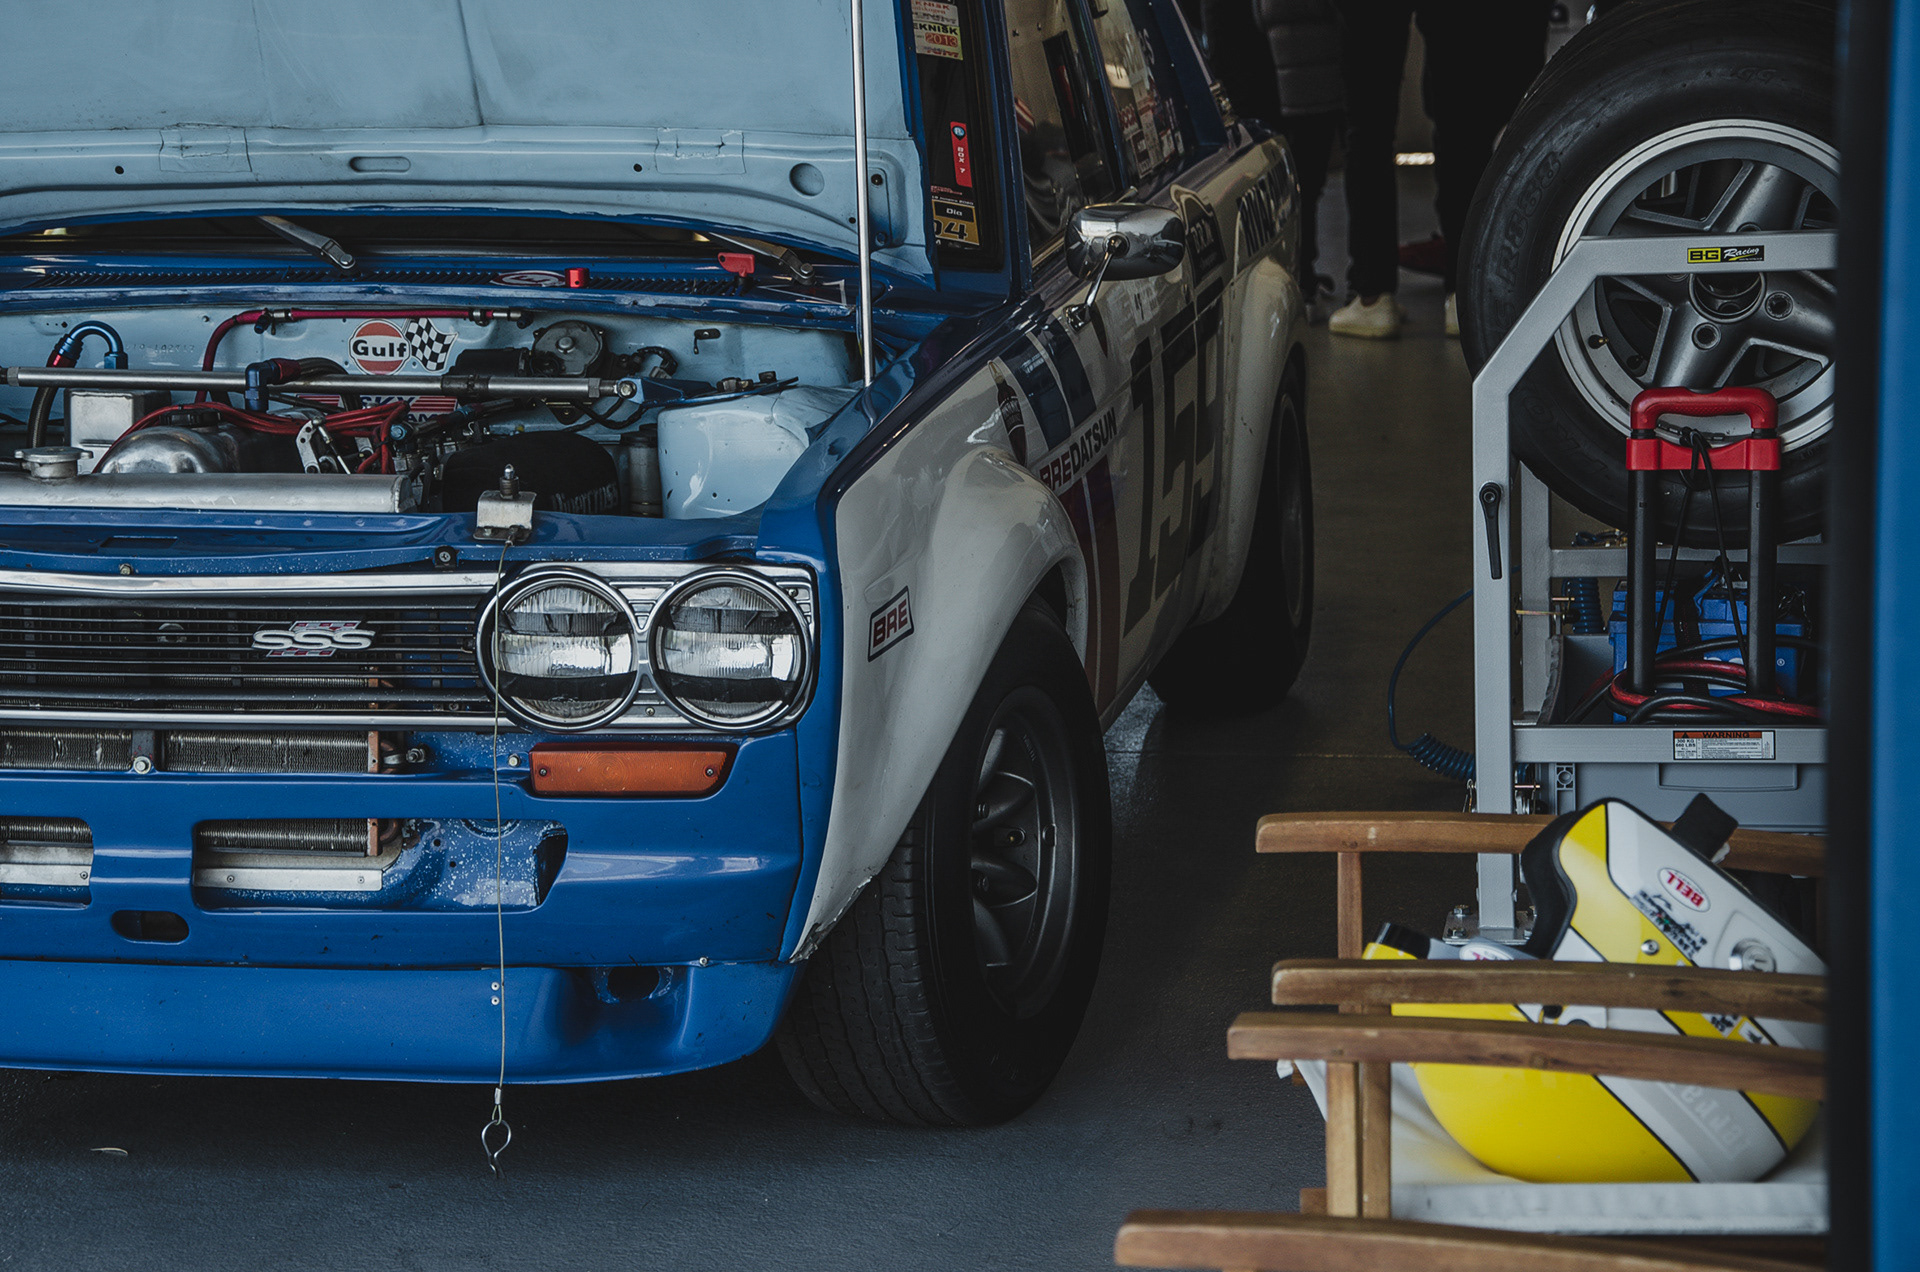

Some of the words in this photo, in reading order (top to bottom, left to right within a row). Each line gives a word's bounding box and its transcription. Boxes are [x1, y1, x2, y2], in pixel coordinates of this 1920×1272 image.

[925, 32, 958, 48] 2013
[946, 207, 963, 217] Dia
[1723, 247, 1760, 259] Racing
[352, 339, 407, 357] Gulf
[872, 598, 908, 648] BRE
[251, 629, 376, 650] SSS
[1702, 731, 1750, 739] WARNING
[1667, 871, 1704, 907] BELL
